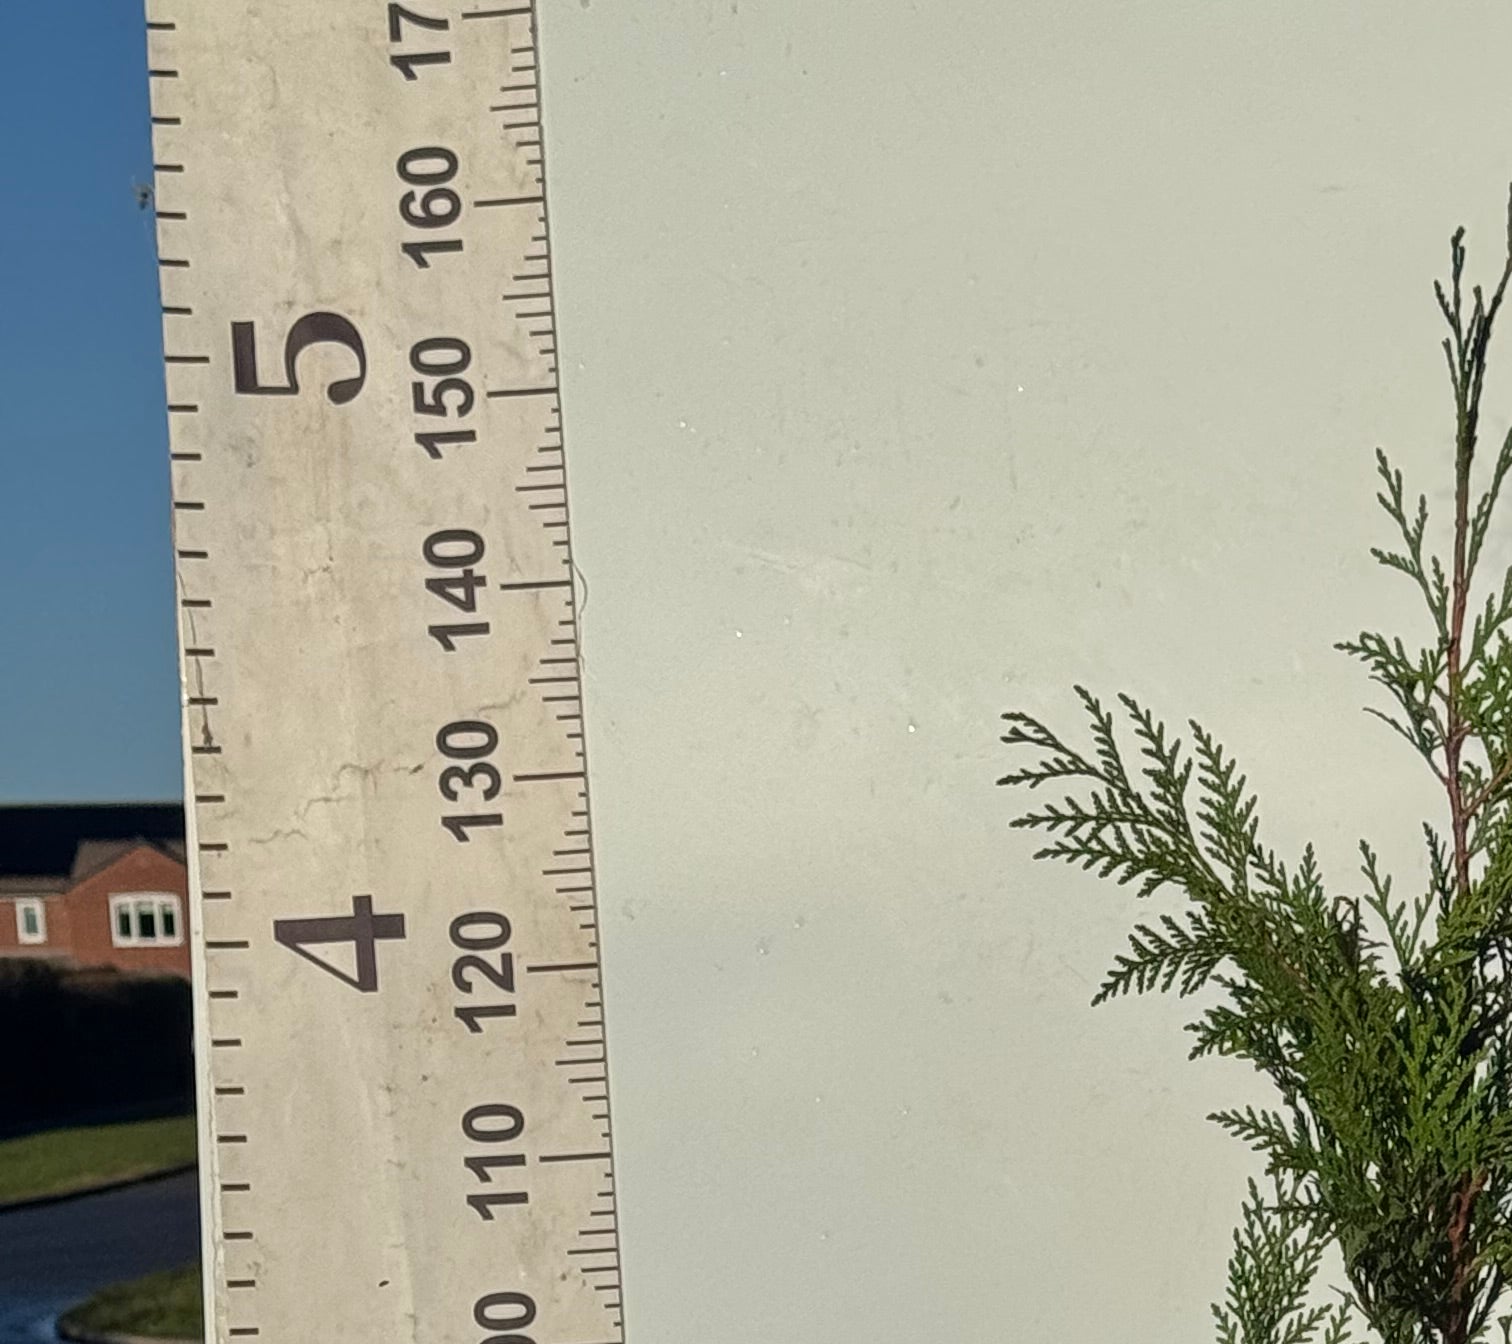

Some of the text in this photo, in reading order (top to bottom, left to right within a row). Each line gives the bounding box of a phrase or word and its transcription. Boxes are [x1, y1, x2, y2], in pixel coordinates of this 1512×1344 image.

[388, 1, 451, 81] 17
[397, 145, 464, 269] 160
[231, 311, 367, 405] 5
[409, 336, 478, 461] 150
[422, 528, 491, 653] 140
[435, 719, 504, 843] 130
[274, 894, 405, 993] 4
[449, 910, 518, 1033] 120
[461, 1103, 530, 1222] 110
